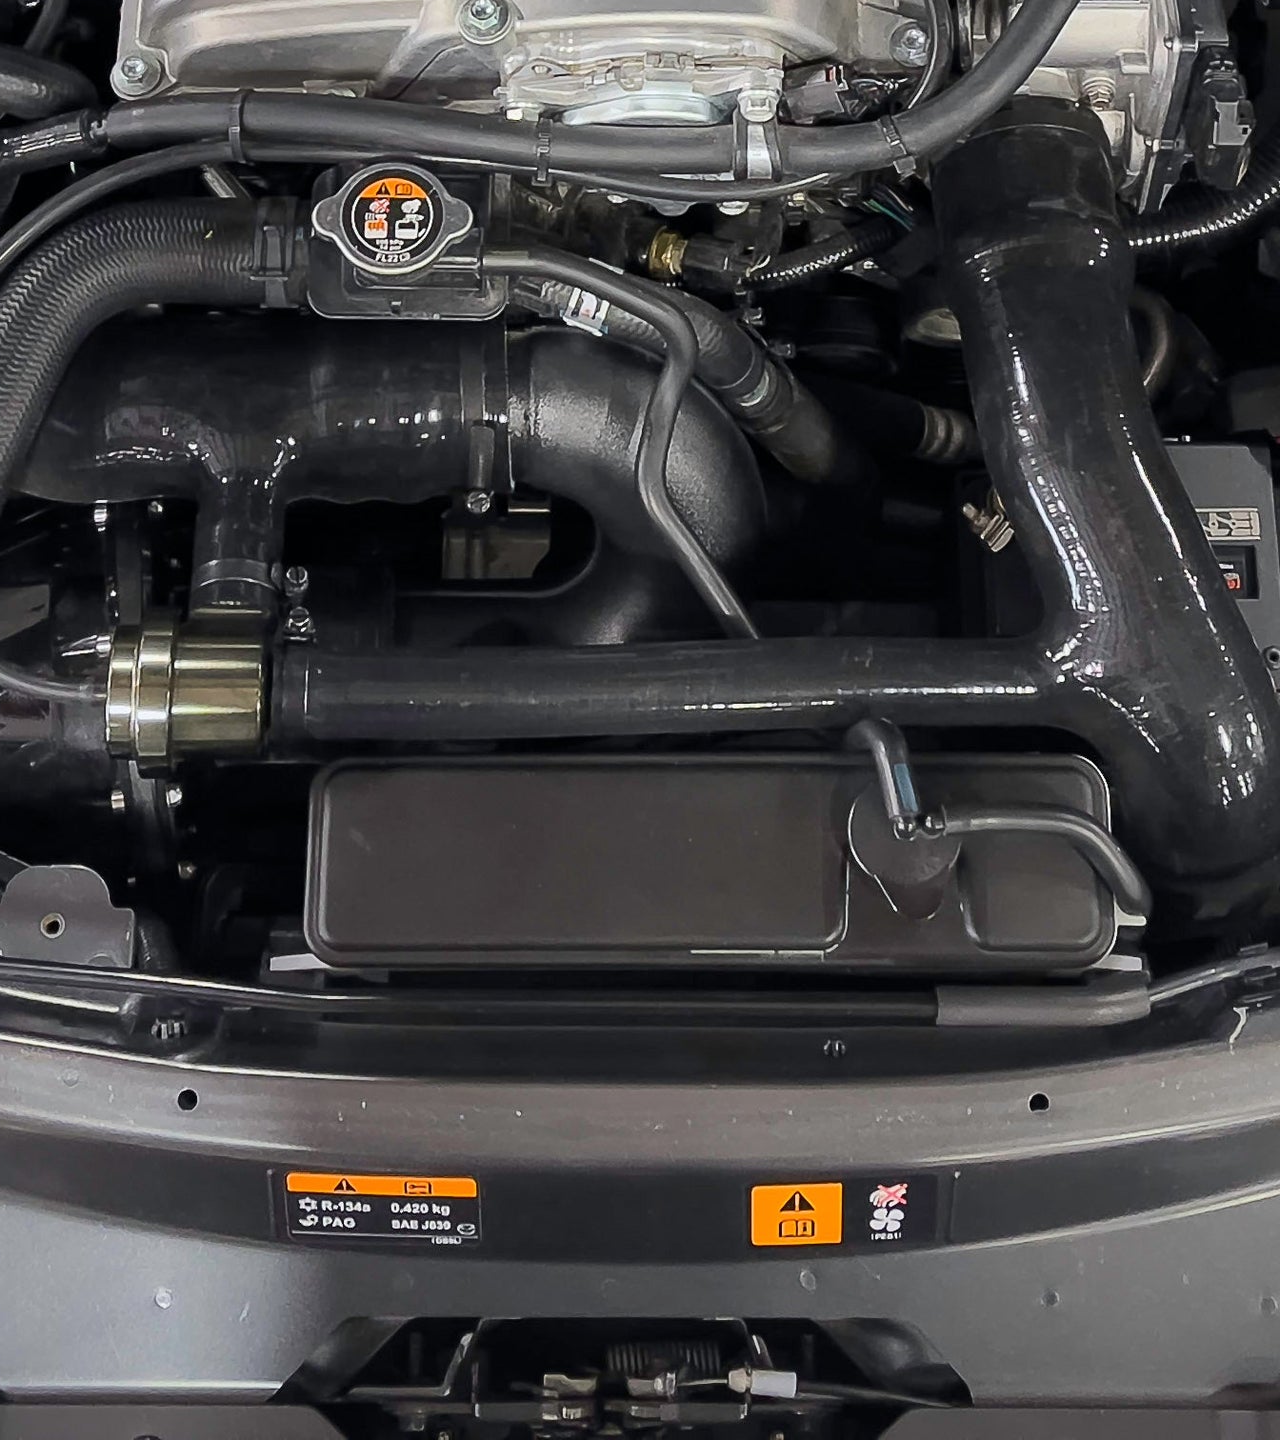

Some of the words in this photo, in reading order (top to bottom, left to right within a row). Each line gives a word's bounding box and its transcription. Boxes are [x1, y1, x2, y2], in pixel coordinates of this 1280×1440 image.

[321, 1201, 371, 1213] R-134a
[390, 1202, 429, 1215] 0.420
[432, 1203, 451, 1216] kg
[322, 1216, 356, 1229] PAG
